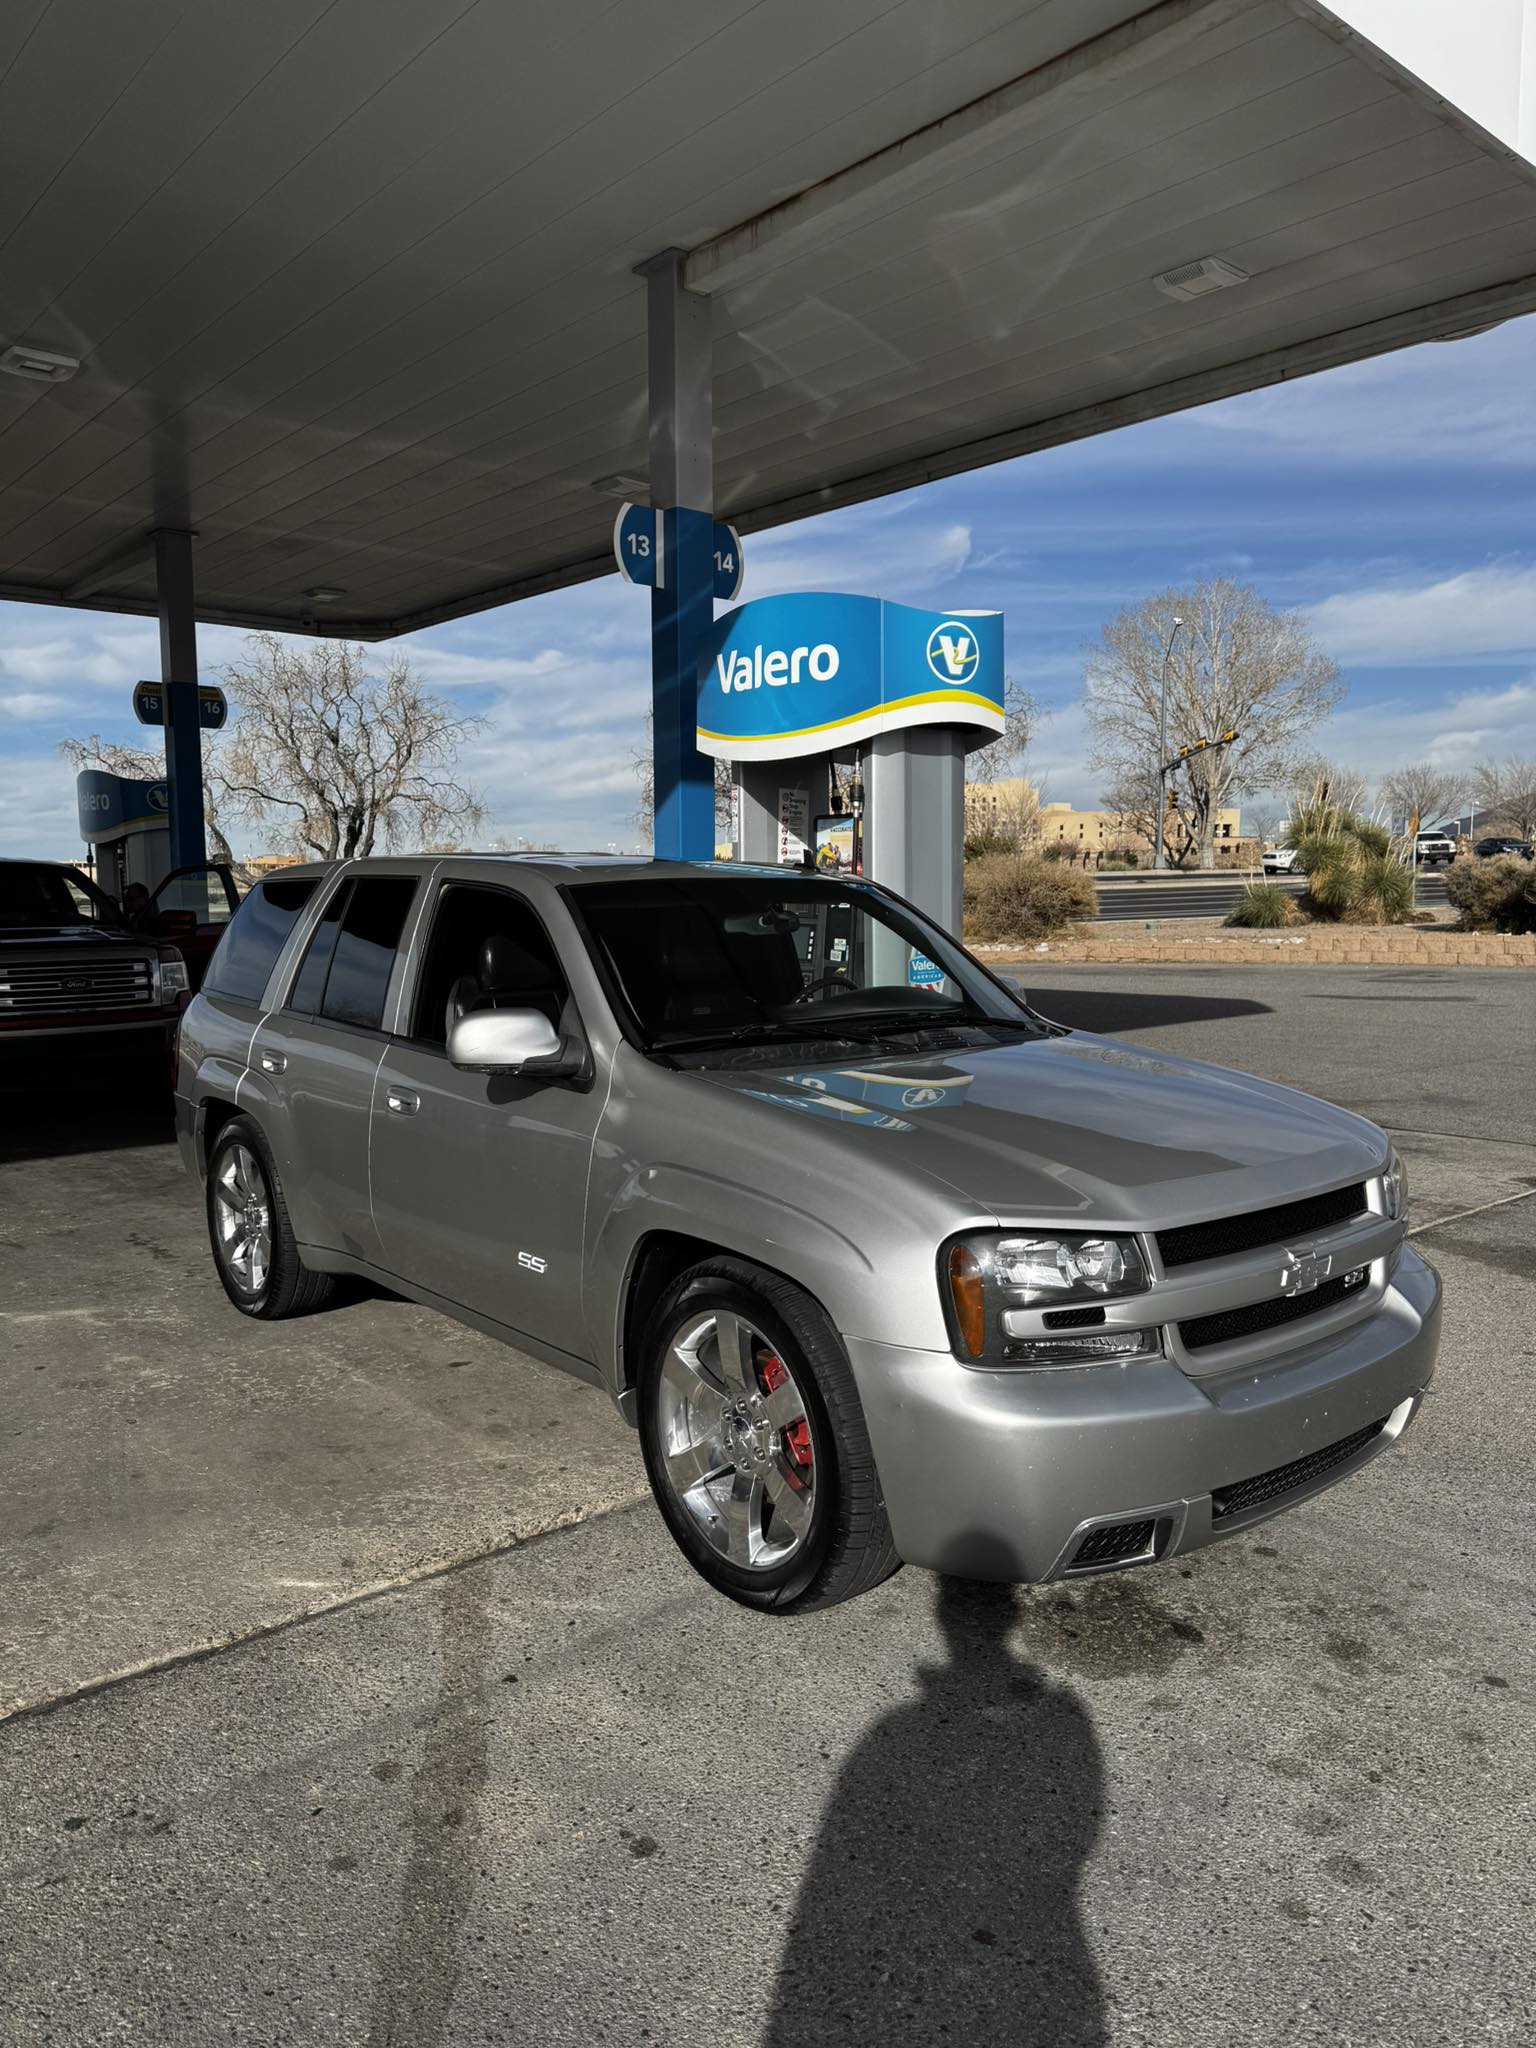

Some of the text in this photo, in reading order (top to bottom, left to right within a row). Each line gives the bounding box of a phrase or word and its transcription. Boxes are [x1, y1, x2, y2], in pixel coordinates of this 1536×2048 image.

[627, 532, 650, 557] 13
[713, 551, 735, 574] 14
[716, 643, 840, 694] Valero
[142, 697, 159, 710] 15
[204, 702, 220, 715] 16
[518, 1251, 545, 1274] SS
